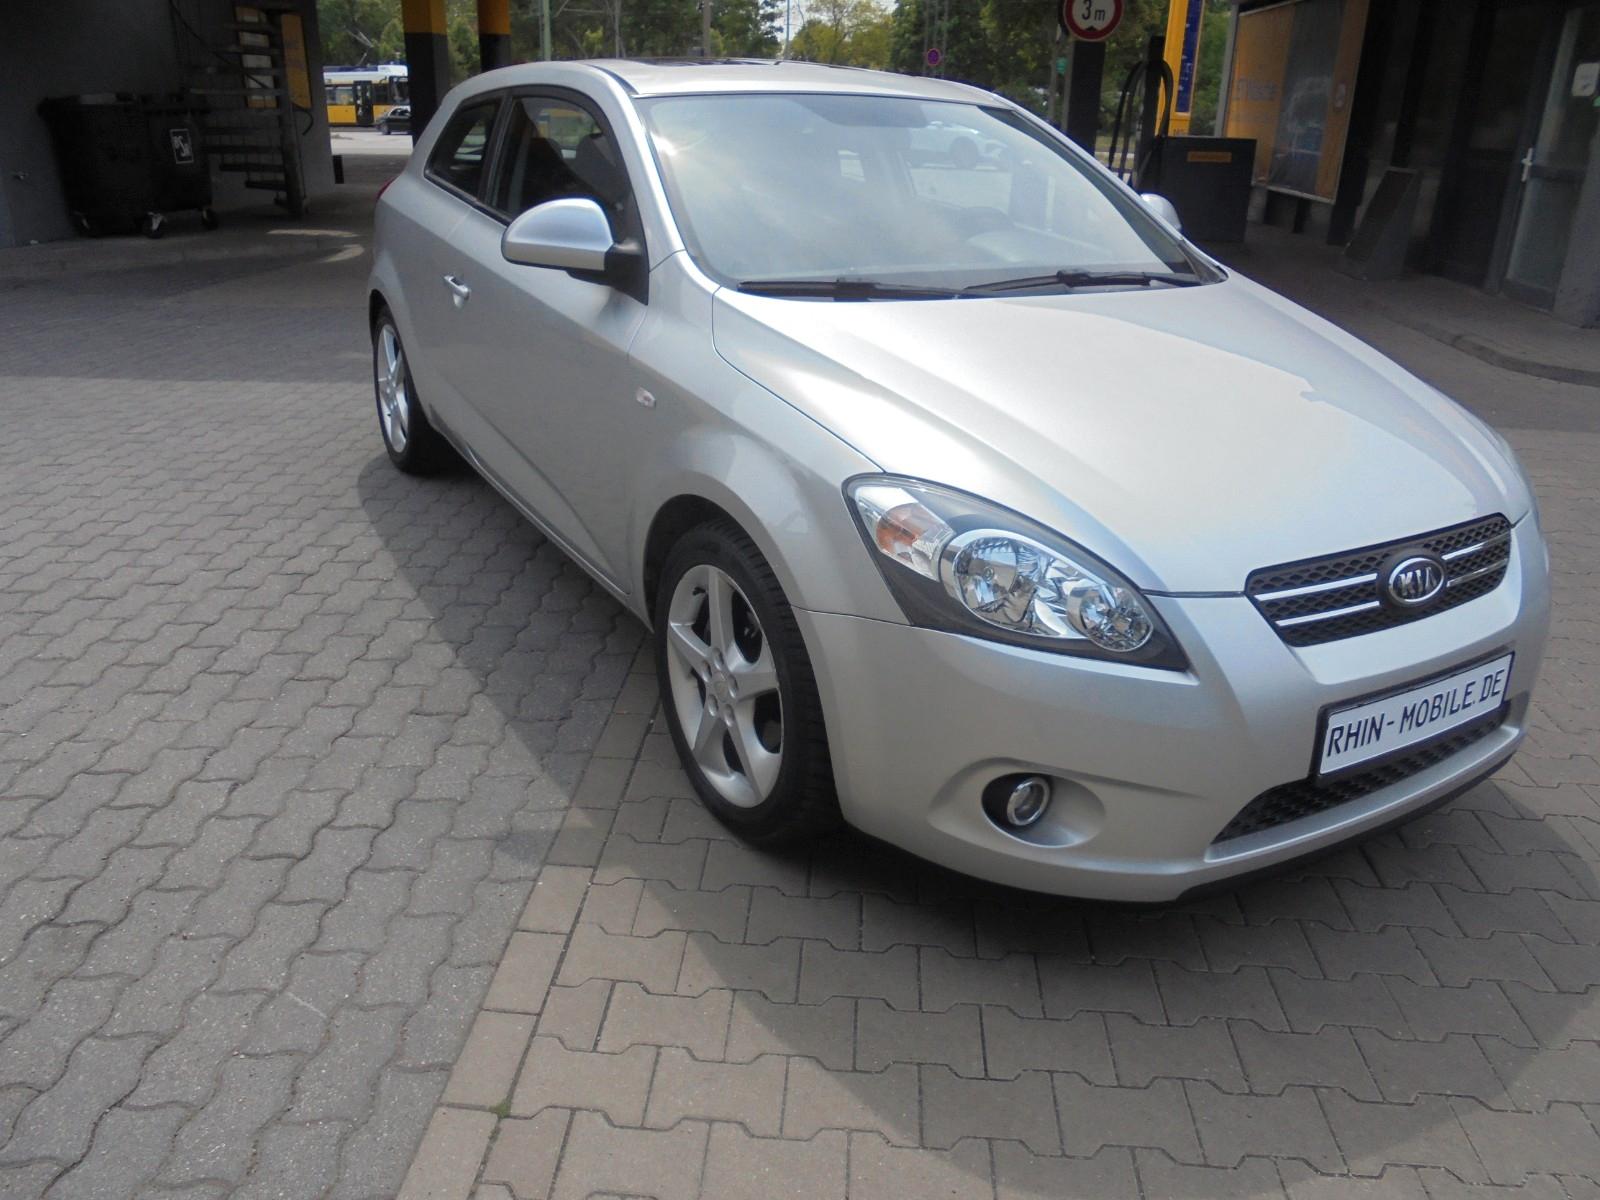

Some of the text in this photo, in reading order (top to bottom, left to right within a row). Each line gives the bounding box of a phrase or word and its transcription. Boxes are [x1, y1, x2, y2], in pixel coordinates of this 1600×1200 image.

[1082, 0, 1106, 21] 3 m
[1399, 566, 1437, 596] KIA
